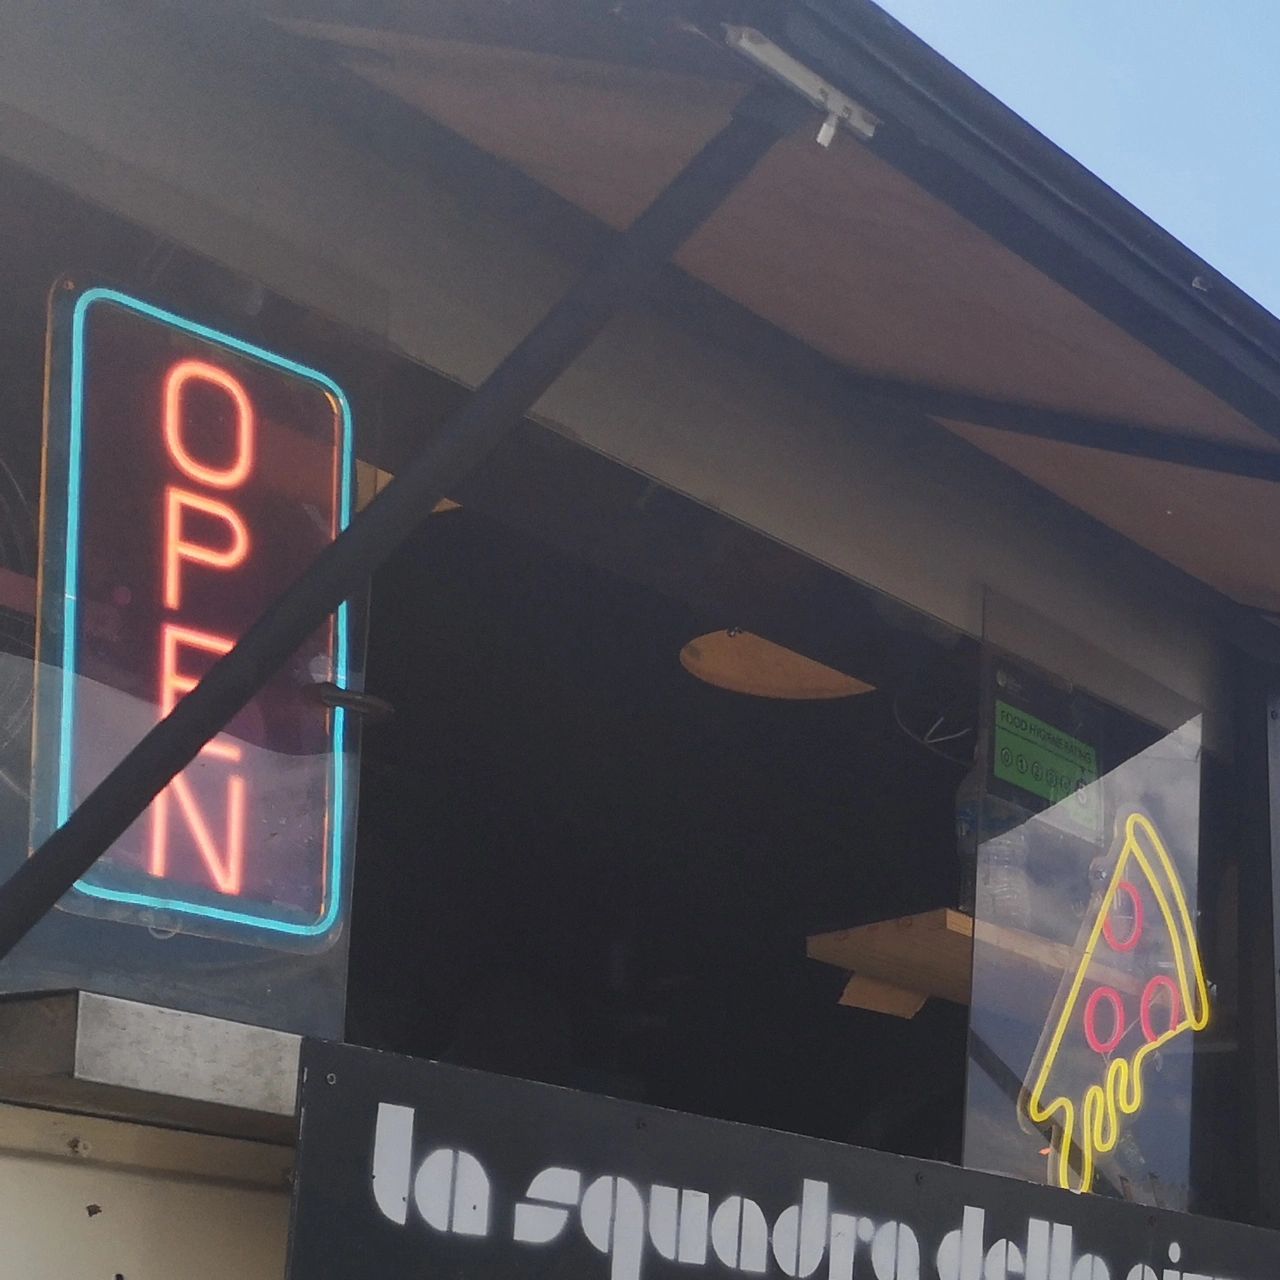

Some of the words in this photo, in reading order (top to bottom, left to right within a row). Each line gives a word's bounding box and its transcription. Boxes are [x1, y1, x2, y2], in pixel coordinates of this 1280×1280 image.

[150, 356, 255, 896] OPEN
[1000, 710, 1028, 731] FOOD
[372, 1102, 490, 1236] la
